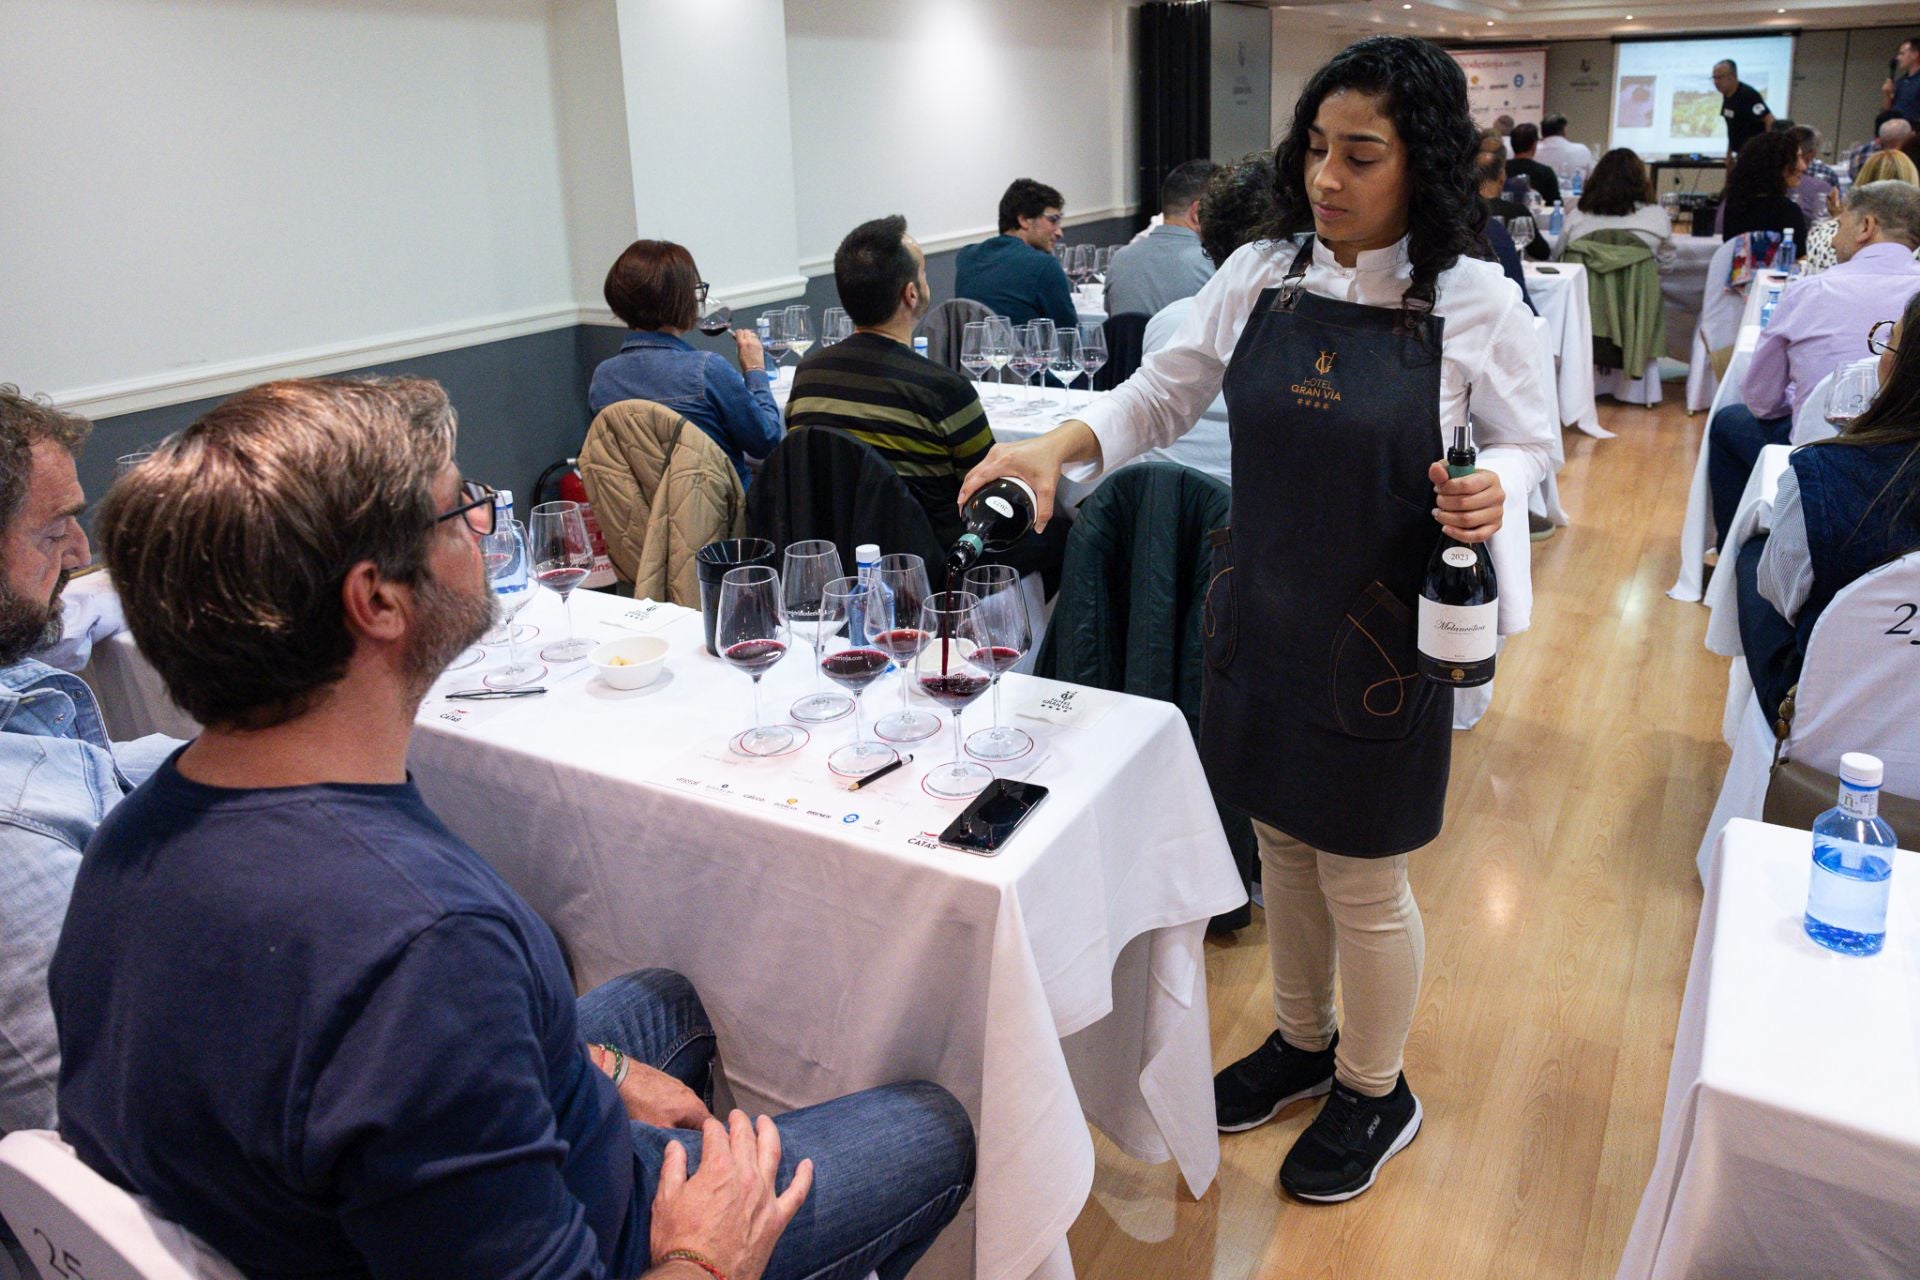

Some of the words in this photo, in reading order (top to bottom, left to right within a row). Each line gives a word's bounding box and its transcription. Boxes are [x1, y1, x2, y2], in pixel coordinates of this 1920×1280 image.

[1303, 376, 1333, 390] HOTEL
[1291, 384, 1321, 398] GRAN
[1884, 603, 1920, 646] 2
[907, 838, 938, 850] CATAS
